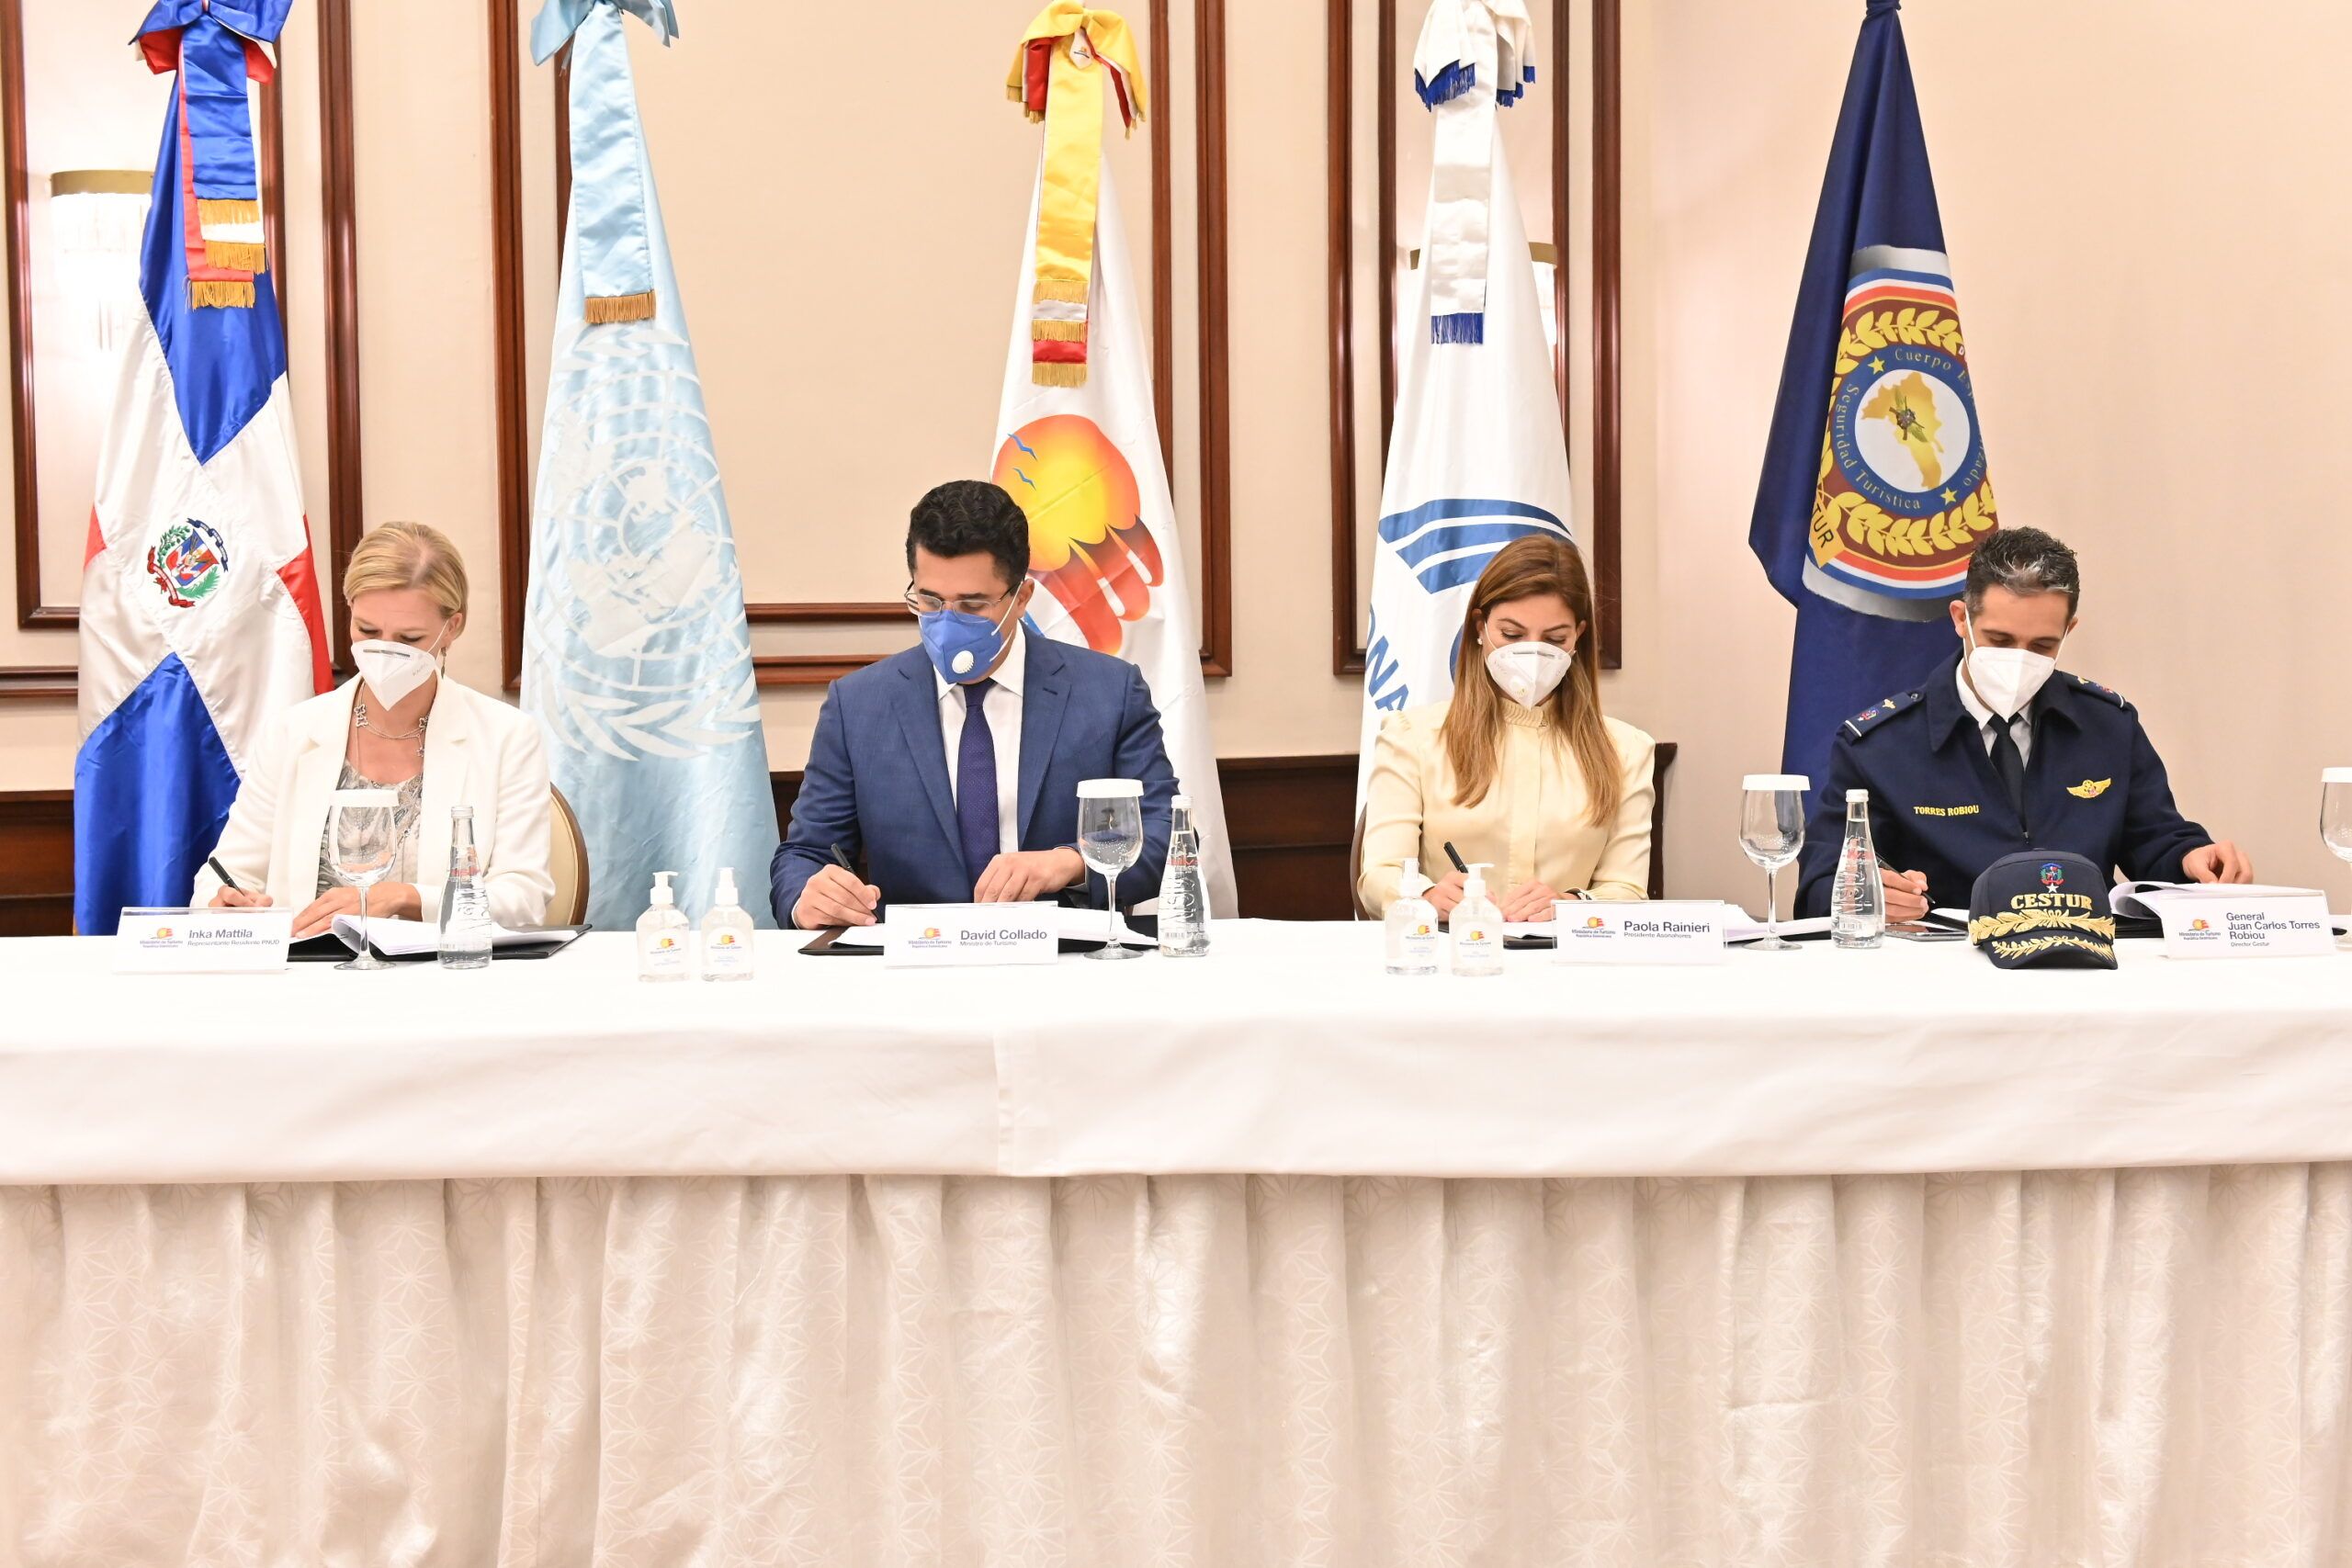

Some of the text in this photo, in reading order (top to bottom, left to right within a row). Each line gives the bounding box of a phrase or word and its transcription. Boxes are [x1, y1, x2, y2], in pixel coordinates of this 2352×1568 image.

[1894, 347, 1951, 371] Cuerpo
[1835, 383, 1860, 469] Seguridad
[1913, 805, 1980, 817] TORRES ROBIOU
[2010, 893, 2093, 910] CESTUR
[2226, 912, 2265, 921] General
[1623, 920, 1710, 932] Paola Rainieri
[2228, 920, 2321, 931] Juan Carlos Torres
[188, 929, 253, 939] Inka Mattila
[960, 930, 1047, 940] David Collado
[2230, 931, 2266, 941] Robiou
